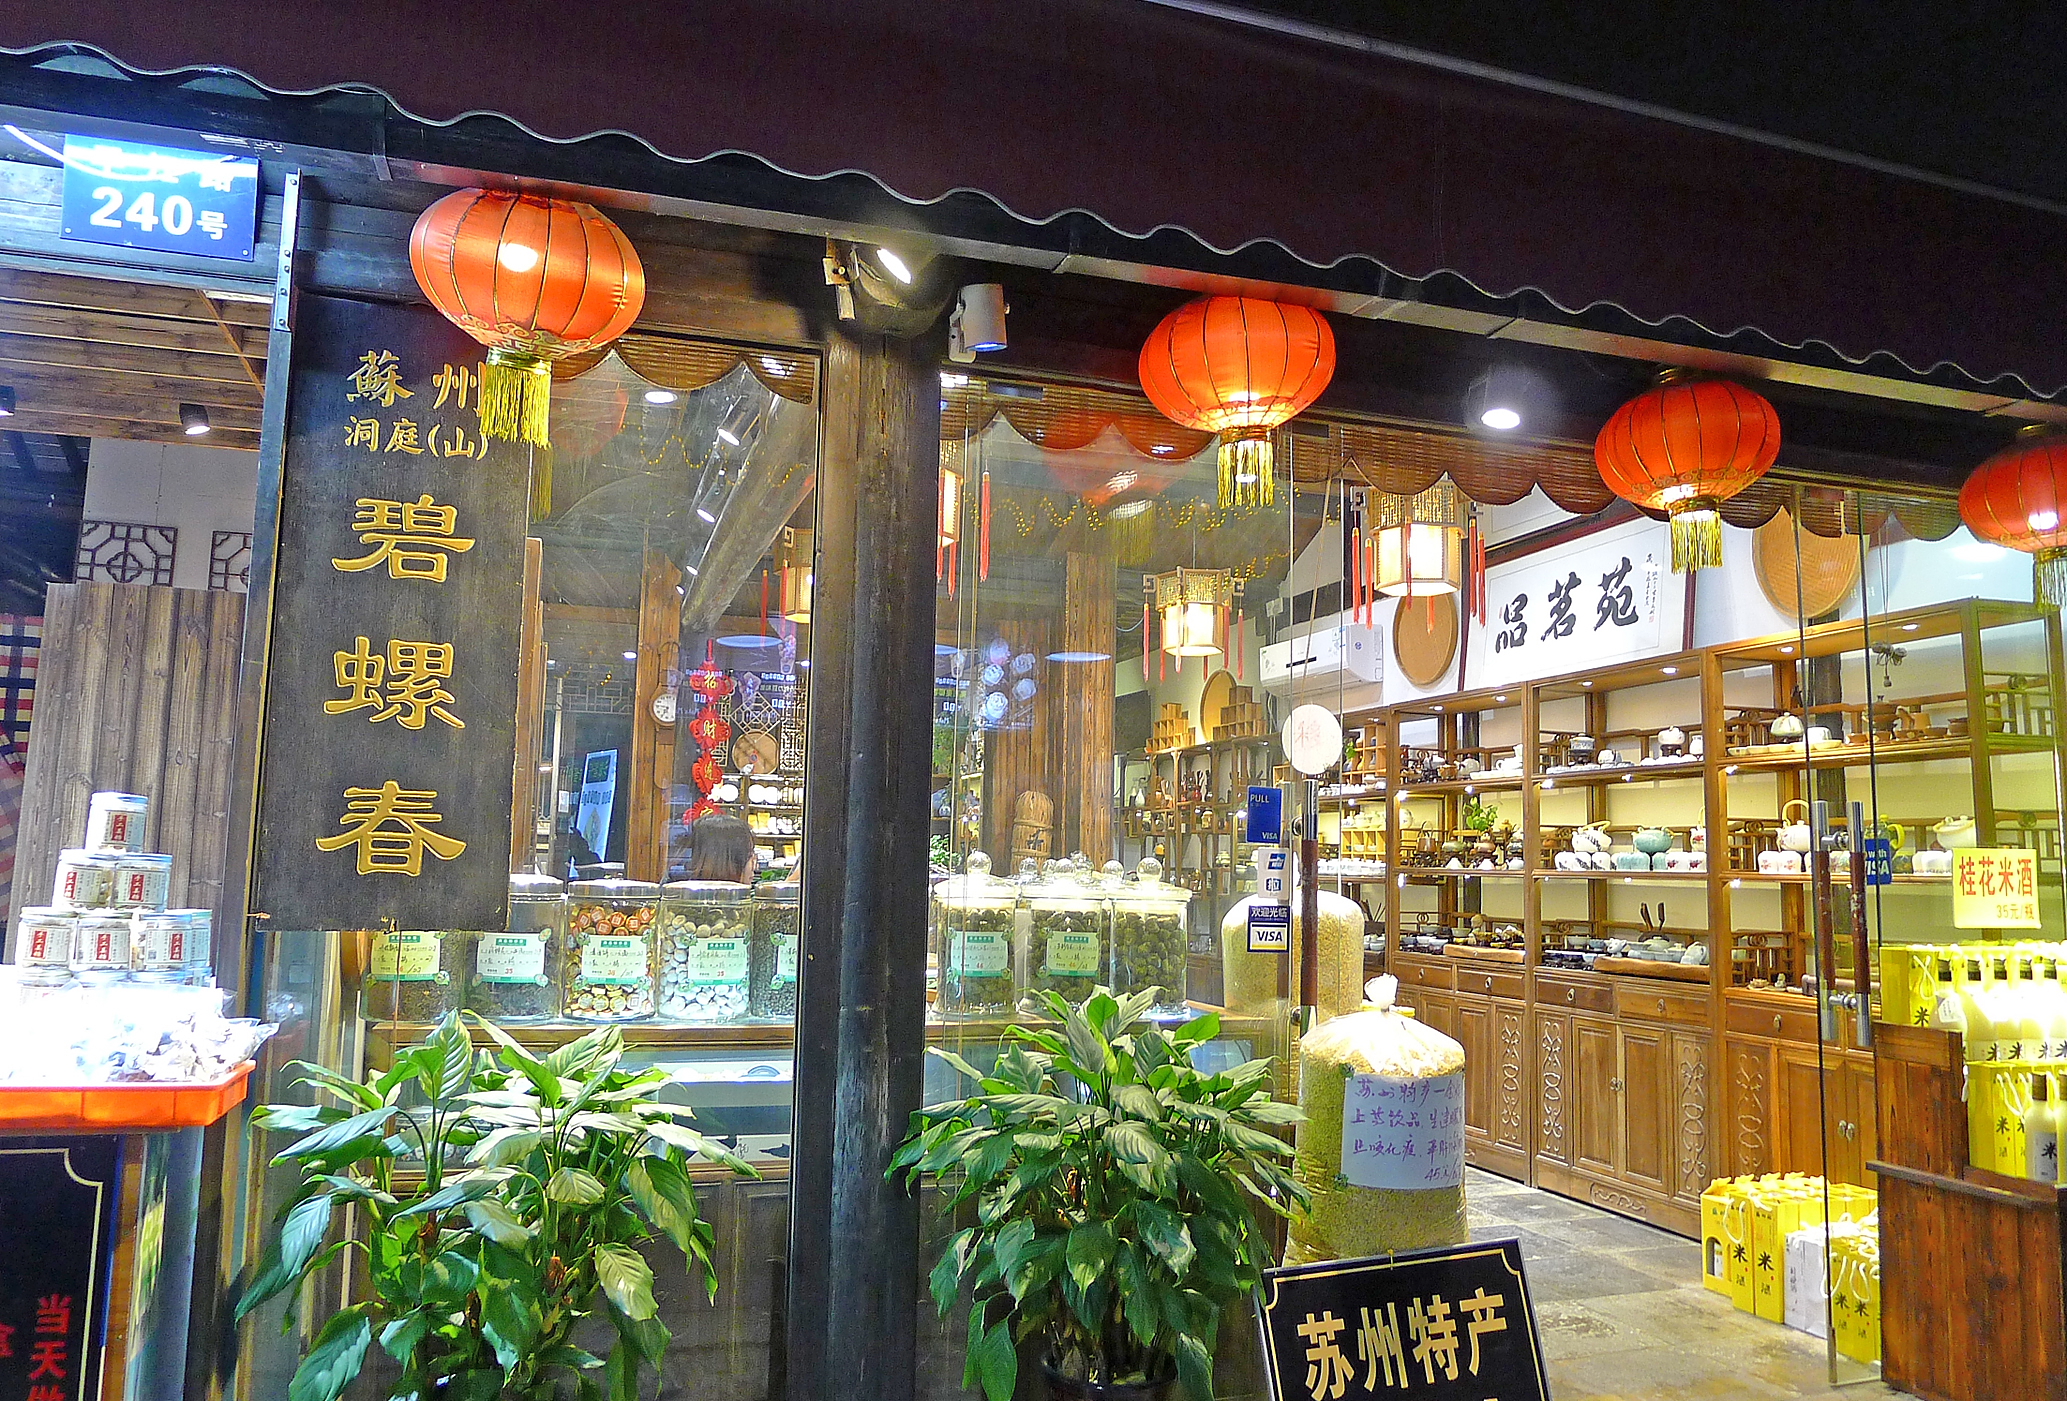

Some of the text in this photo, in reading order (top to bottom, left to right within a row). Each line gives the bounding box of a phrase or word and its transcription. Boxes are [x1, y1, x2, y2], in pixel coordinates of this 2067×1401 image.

[90, 186, 228, 240] 240号
[346, 350, 486, 417] 蘇州
[343, 415, 489, 461] 洞庭(山)
[315, 494, 477, 876] 碧螺春
[1250, 794, 1270, 803] PULL
[1261, 831, 1279, 840] VISA
[1958, 856, 2034, 897] 桂花米酒
[1251, 907, 1288, 918] 欢迎光临
[1256, 931, 1283, 942] VISA
[1996, 1116, 2010, 1135] 米
[1733, 1243, 1748, 1263] 米
[1758, 1251, 1774, 1271] 米
[1834, 1292, 1850, 1310] 米
[1854, 1300, 1870, 1317] 米
[1297, 1286, 1507, 1401] 苏州特产
